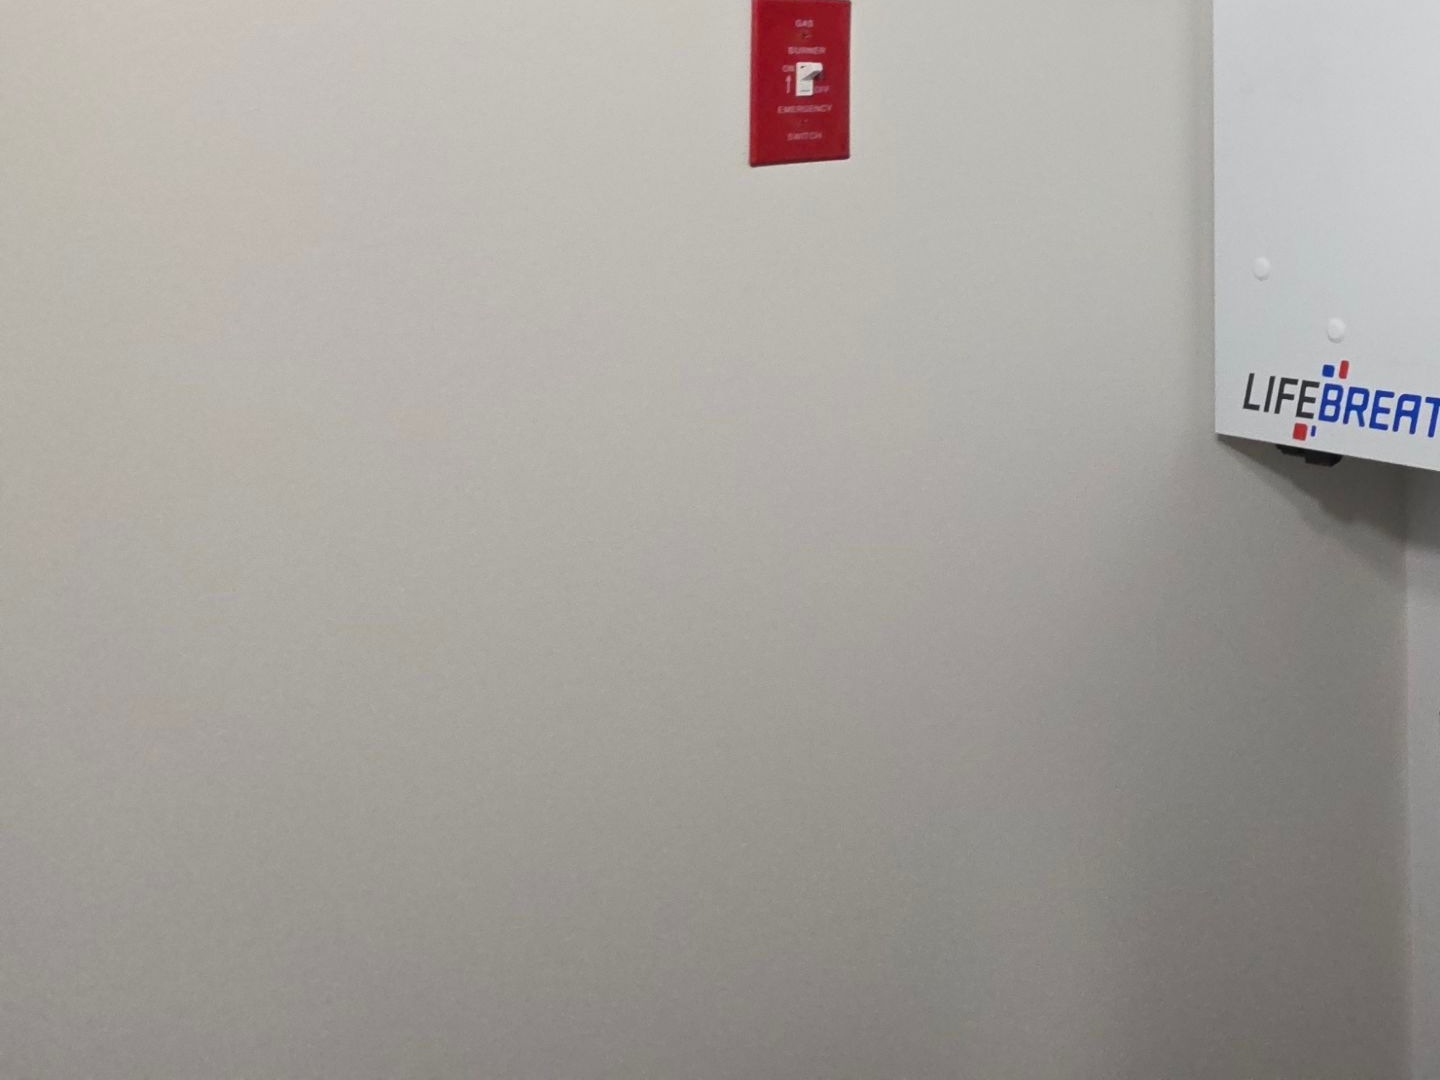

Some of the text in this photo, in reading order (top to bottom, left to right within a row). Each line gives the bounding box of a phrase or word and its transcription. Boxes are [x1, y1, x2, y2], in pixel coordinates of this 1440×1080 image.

[795, 19, 814, 28] GAS
[787, 47, 826, 55] BURNER
[777, 104, 833, 114] EMERGENCY
[787, 132, 823, 141] SWITCH
